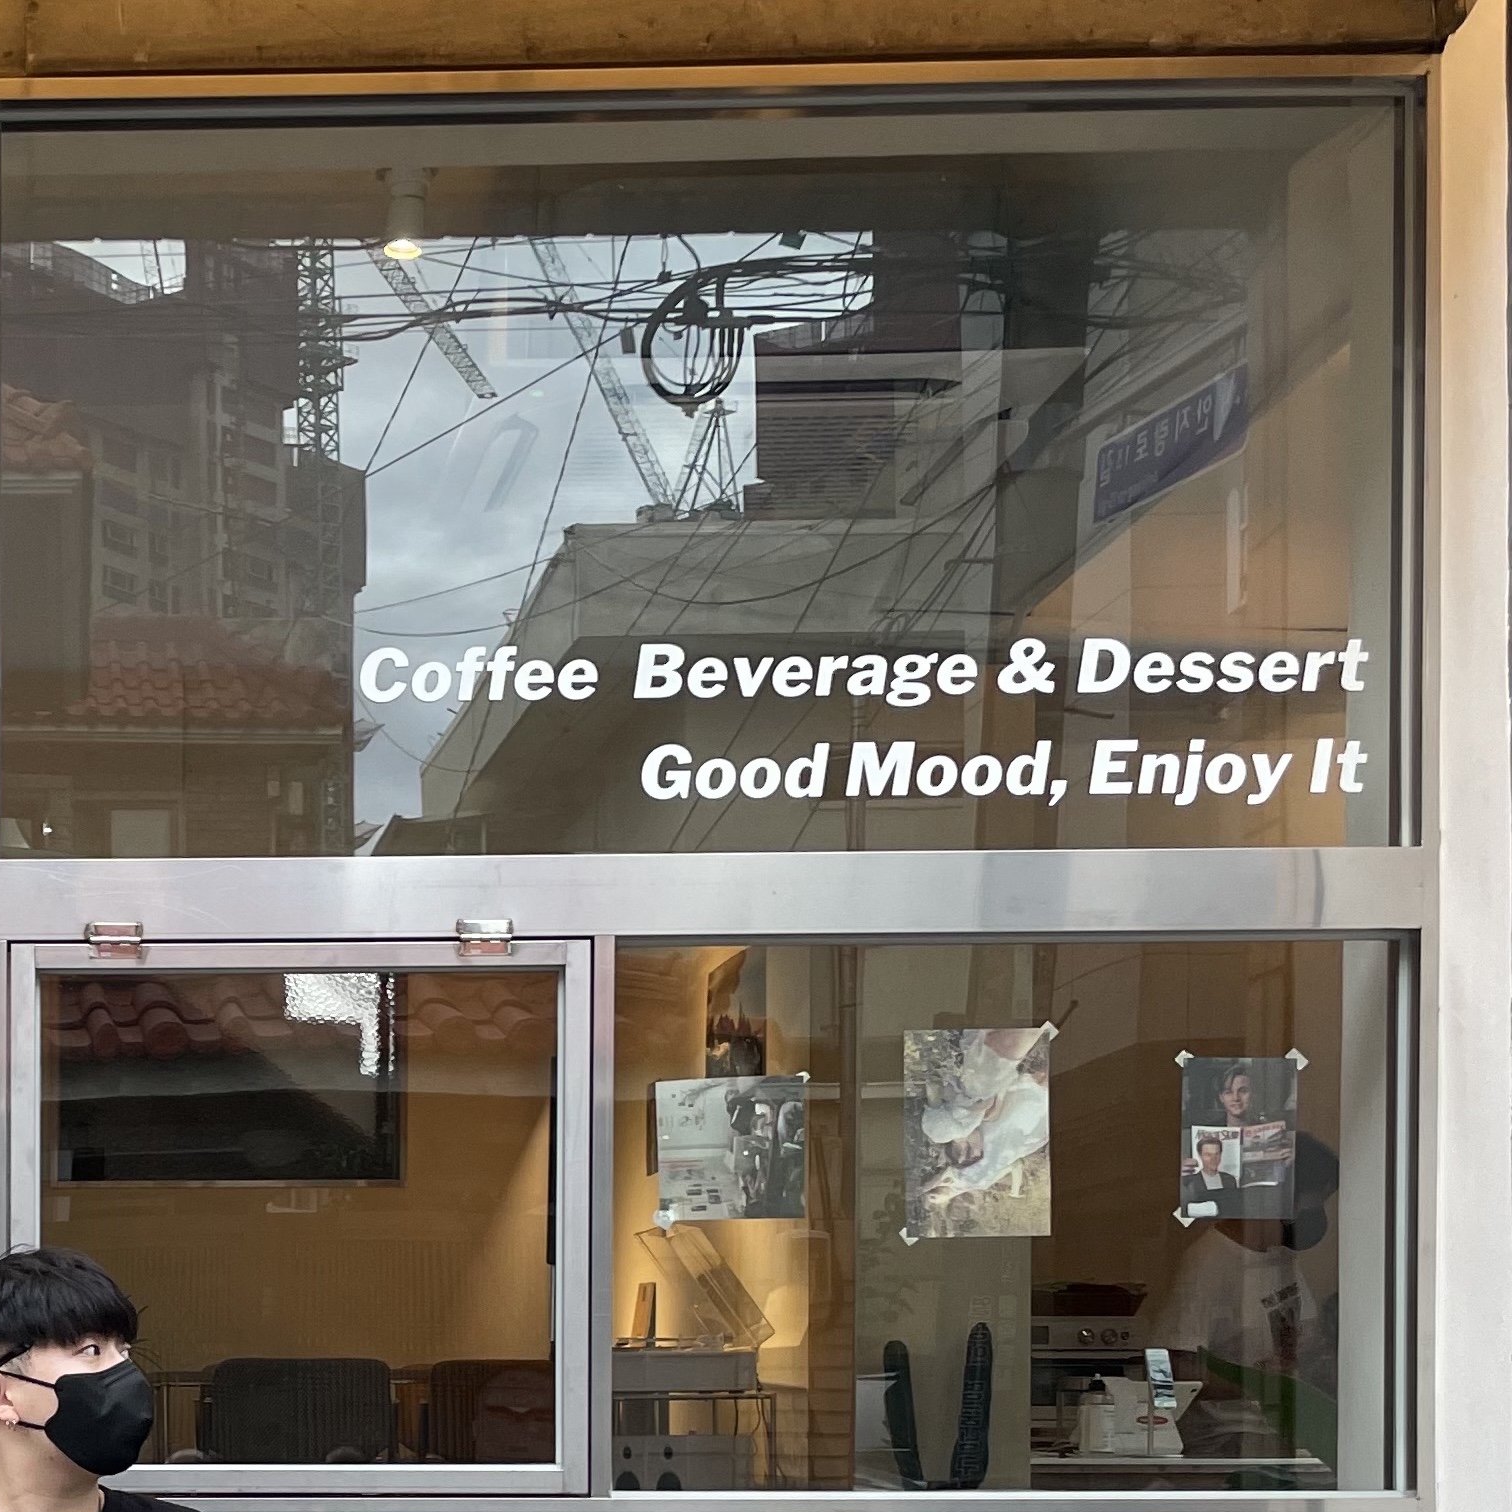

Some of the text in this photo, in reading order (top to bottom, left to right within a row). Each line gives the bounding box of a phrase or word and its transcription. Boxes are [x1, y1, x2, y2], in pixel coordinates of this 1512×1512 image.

[359, 638, 1369, 707] Coffee Beverage & Dessert
[641, 738, 1368, 806] Good Mood, Enjoy It
